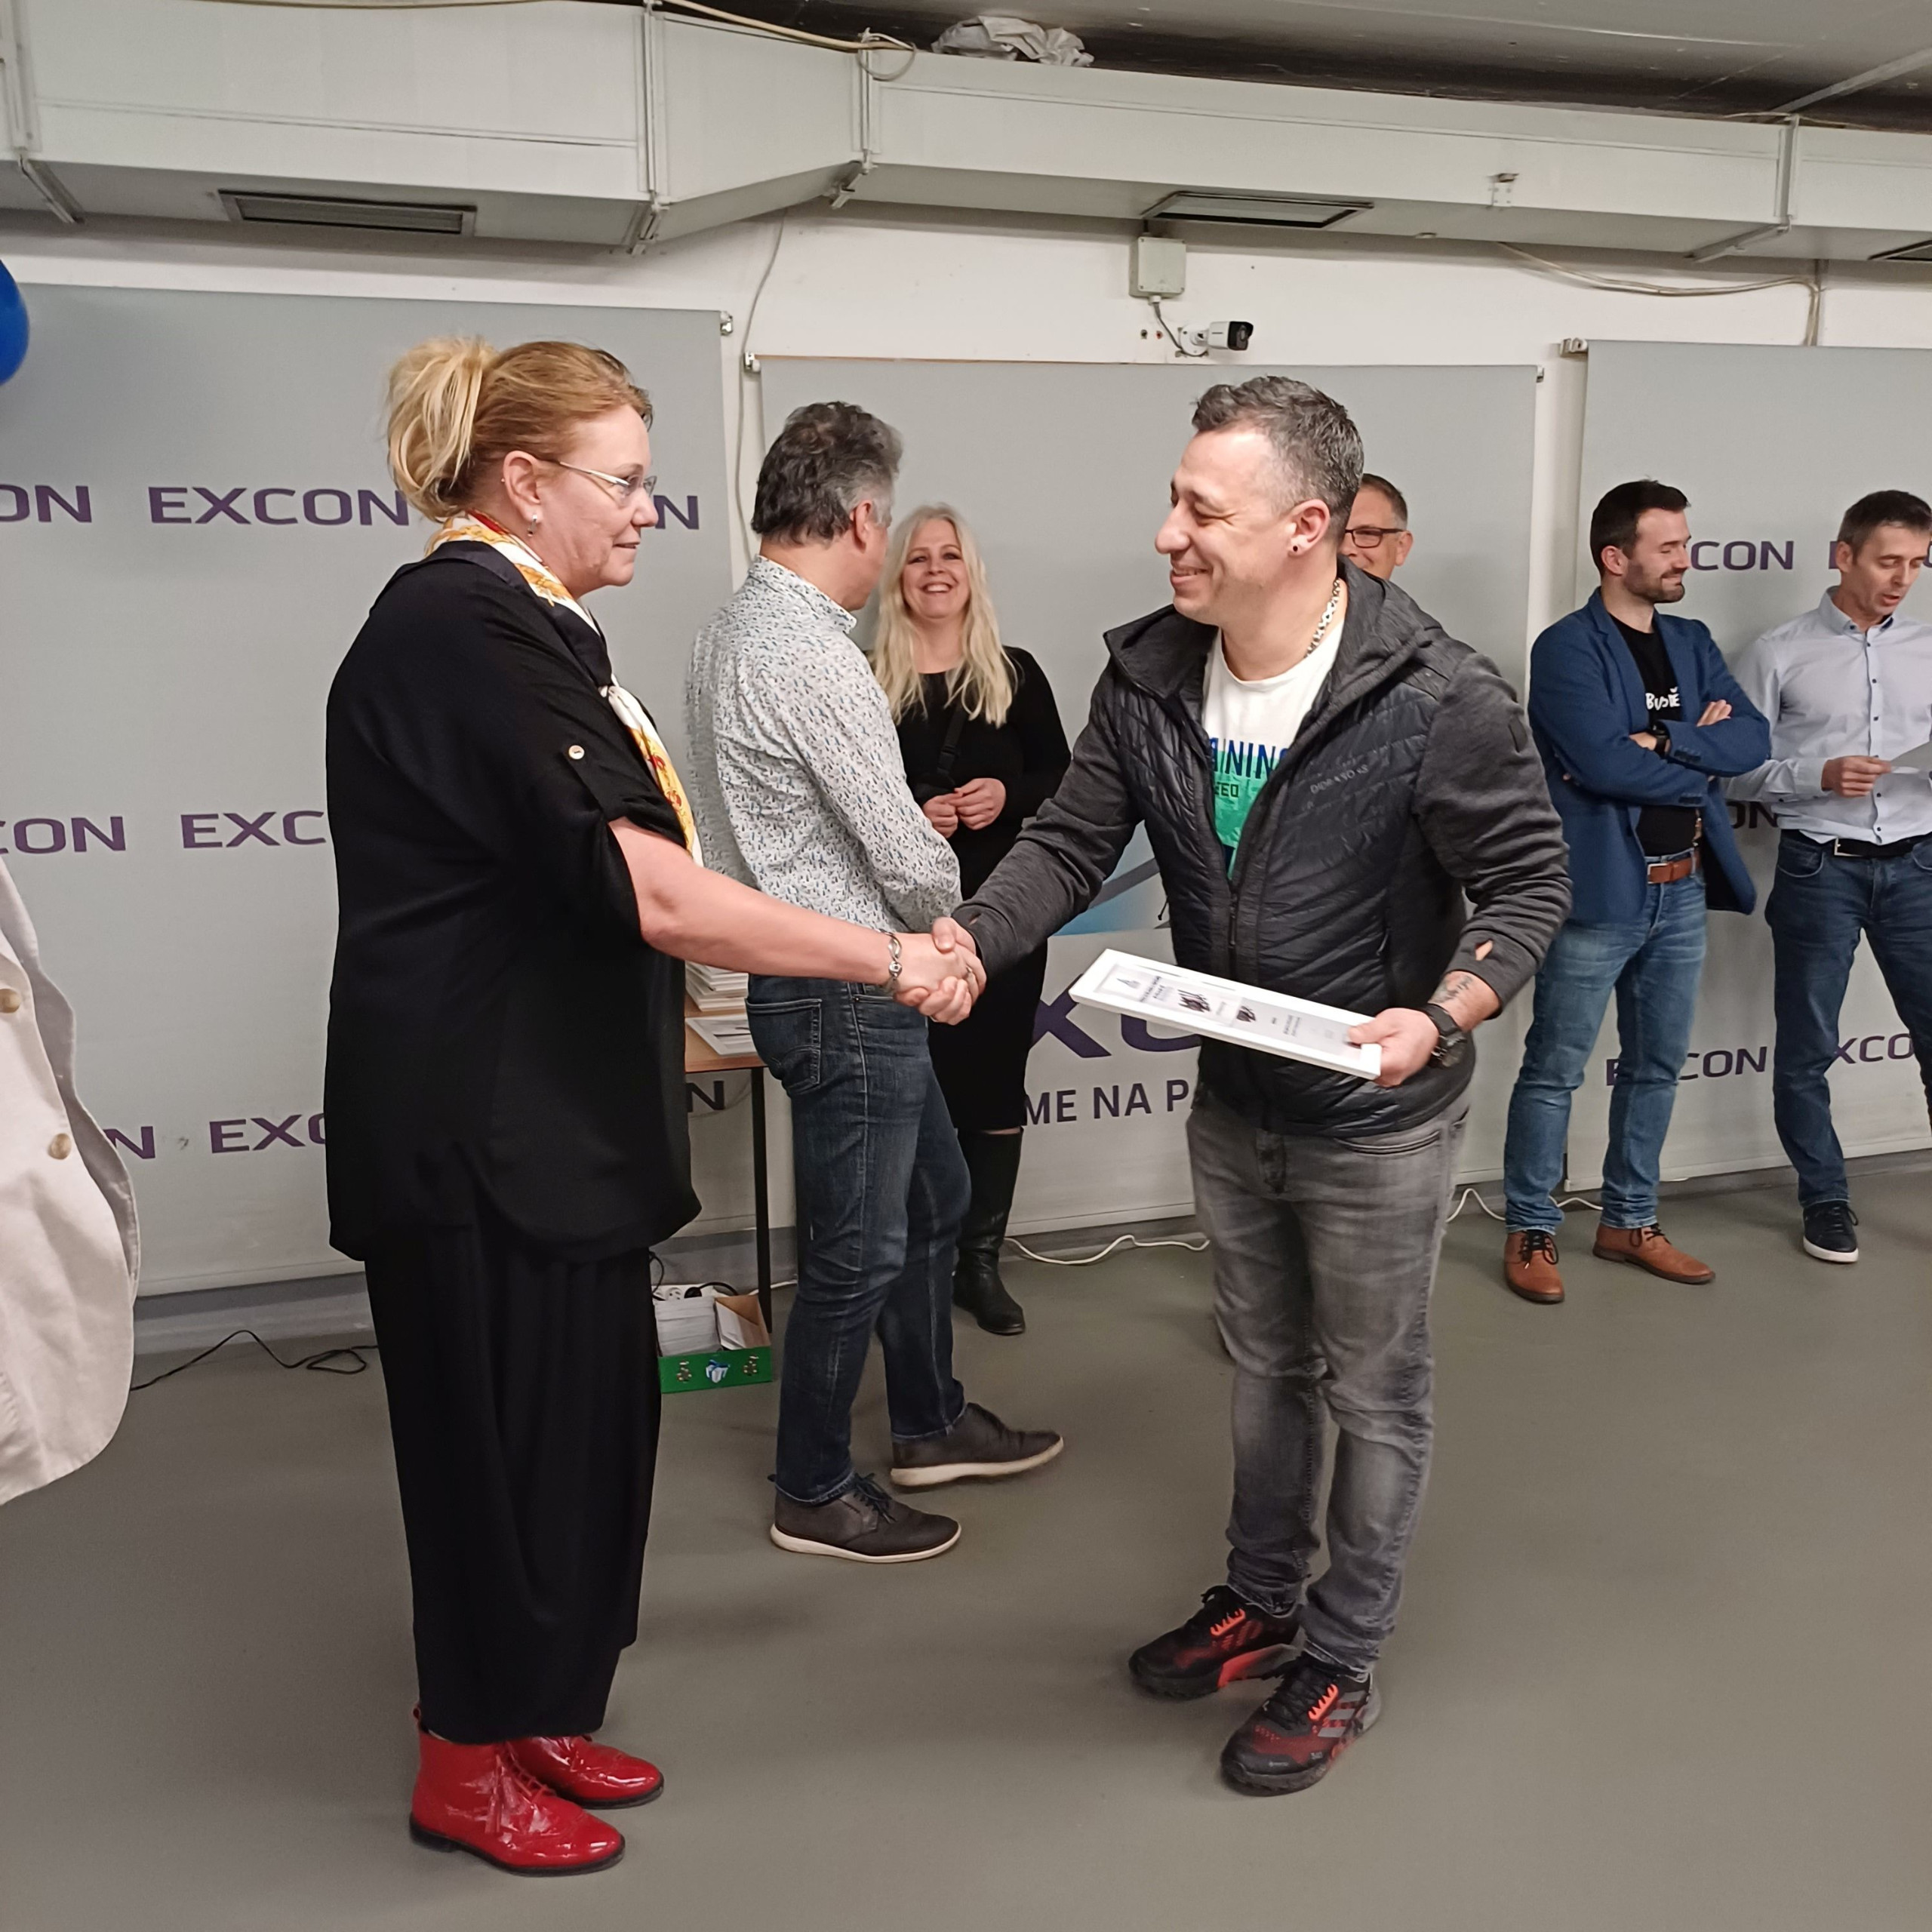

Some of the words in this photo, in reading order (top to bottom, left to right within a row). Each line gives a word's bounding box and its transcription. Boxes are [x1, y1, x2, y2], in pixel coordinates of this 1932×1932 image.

[149, 486, 409, 525] EXCON
[1690, 540, 1794, 571] CON
[0, 816, 126, 854] ON
[180, 810, 326, 848] EXC
[1094, 1082, 1152, 1119] NA
